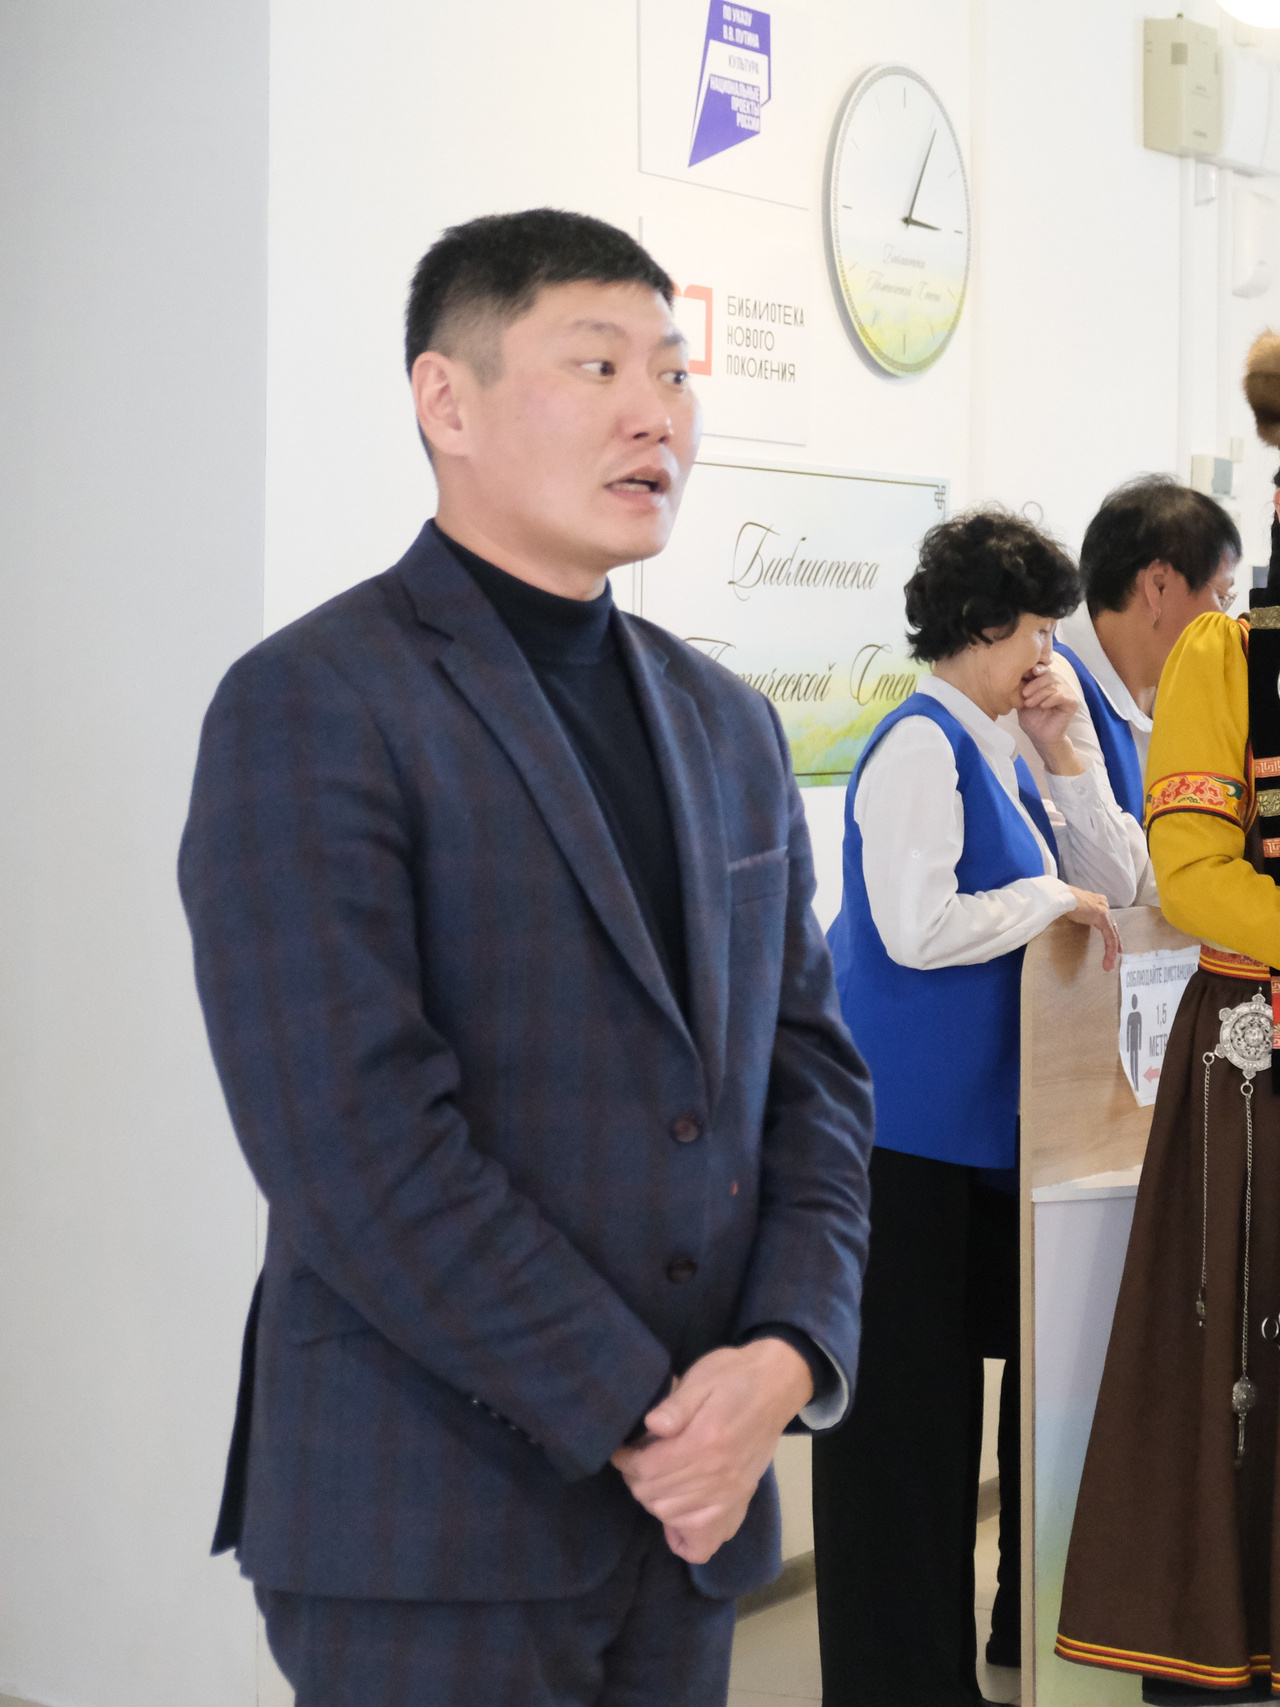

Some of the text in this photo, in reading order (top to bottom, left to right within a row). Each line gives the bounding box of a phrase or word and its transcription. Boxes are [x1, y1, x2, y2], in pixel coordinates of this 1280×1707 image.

[727, 295, 805, 327] БИБЛИОТЕКА
[726, 325, 775, 351] НОВОГО
[726, 354, 796, 383] ПОКОЛЕНИЯ
[728, 521, 880, 601] Библиотека
[849, 643, 917, 706] Степ
[1156, 1003, 1167, 1028] 1,5
